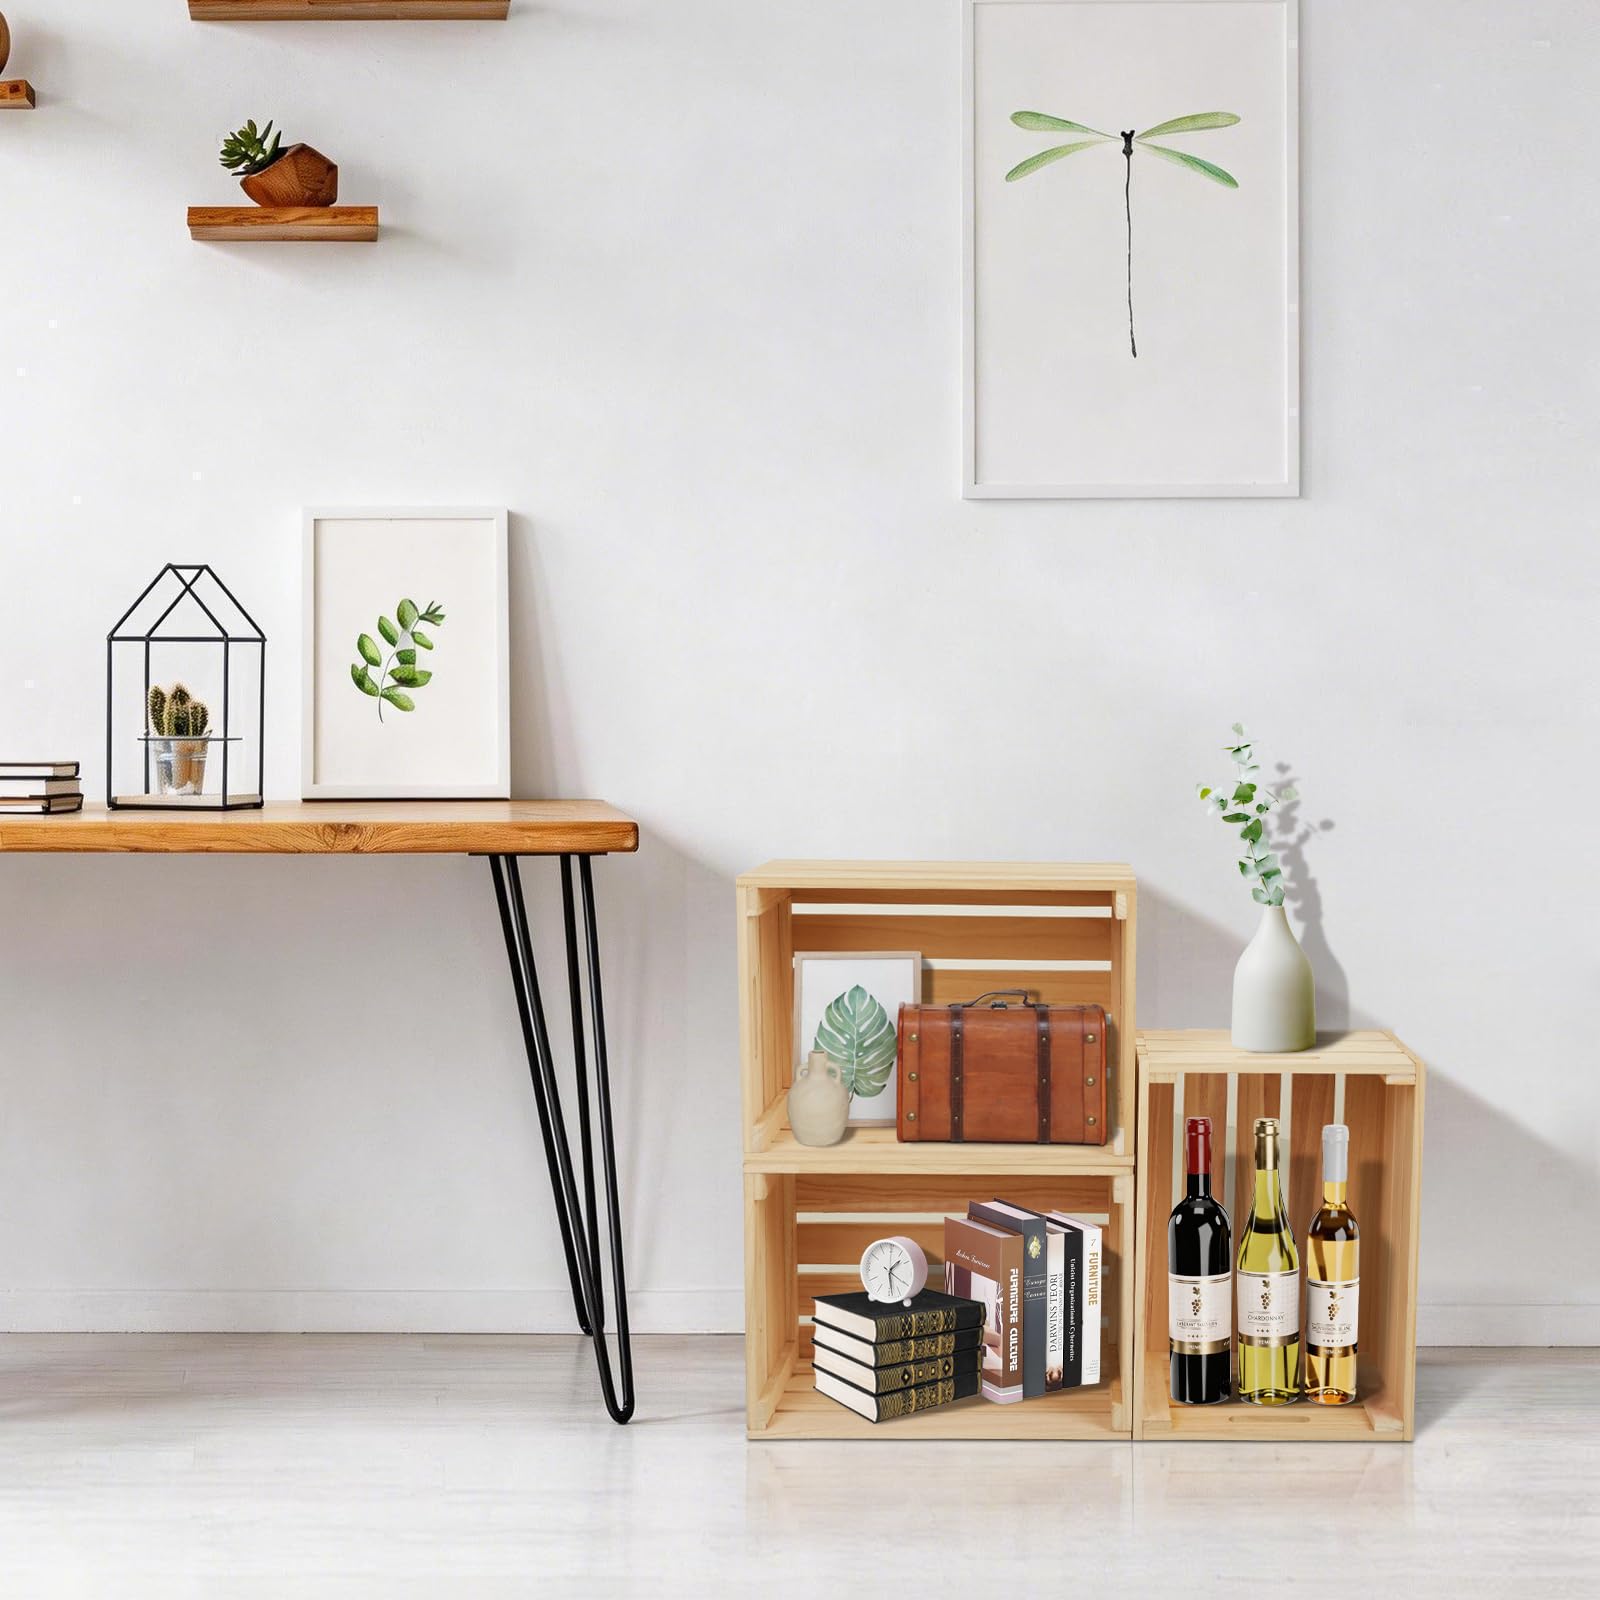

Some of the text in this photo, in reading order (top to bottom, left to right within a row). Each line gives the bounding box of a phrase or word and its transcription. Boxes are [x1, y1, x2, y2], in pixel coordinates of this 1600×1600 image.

[1069, 1281, 1077, 1325] Organizational
[1088, 1251, 1099, 1306] FURNITURE
[1009, 1267, 1019, 1373] FURNITURE CULTURE
[1049, 1273, 1058, 1353] DARWINS TEORI
[1247, 1314, 1284, 1322] CHARDONNAY
[1068, 1326, 1077, 1362] Cybernetics
